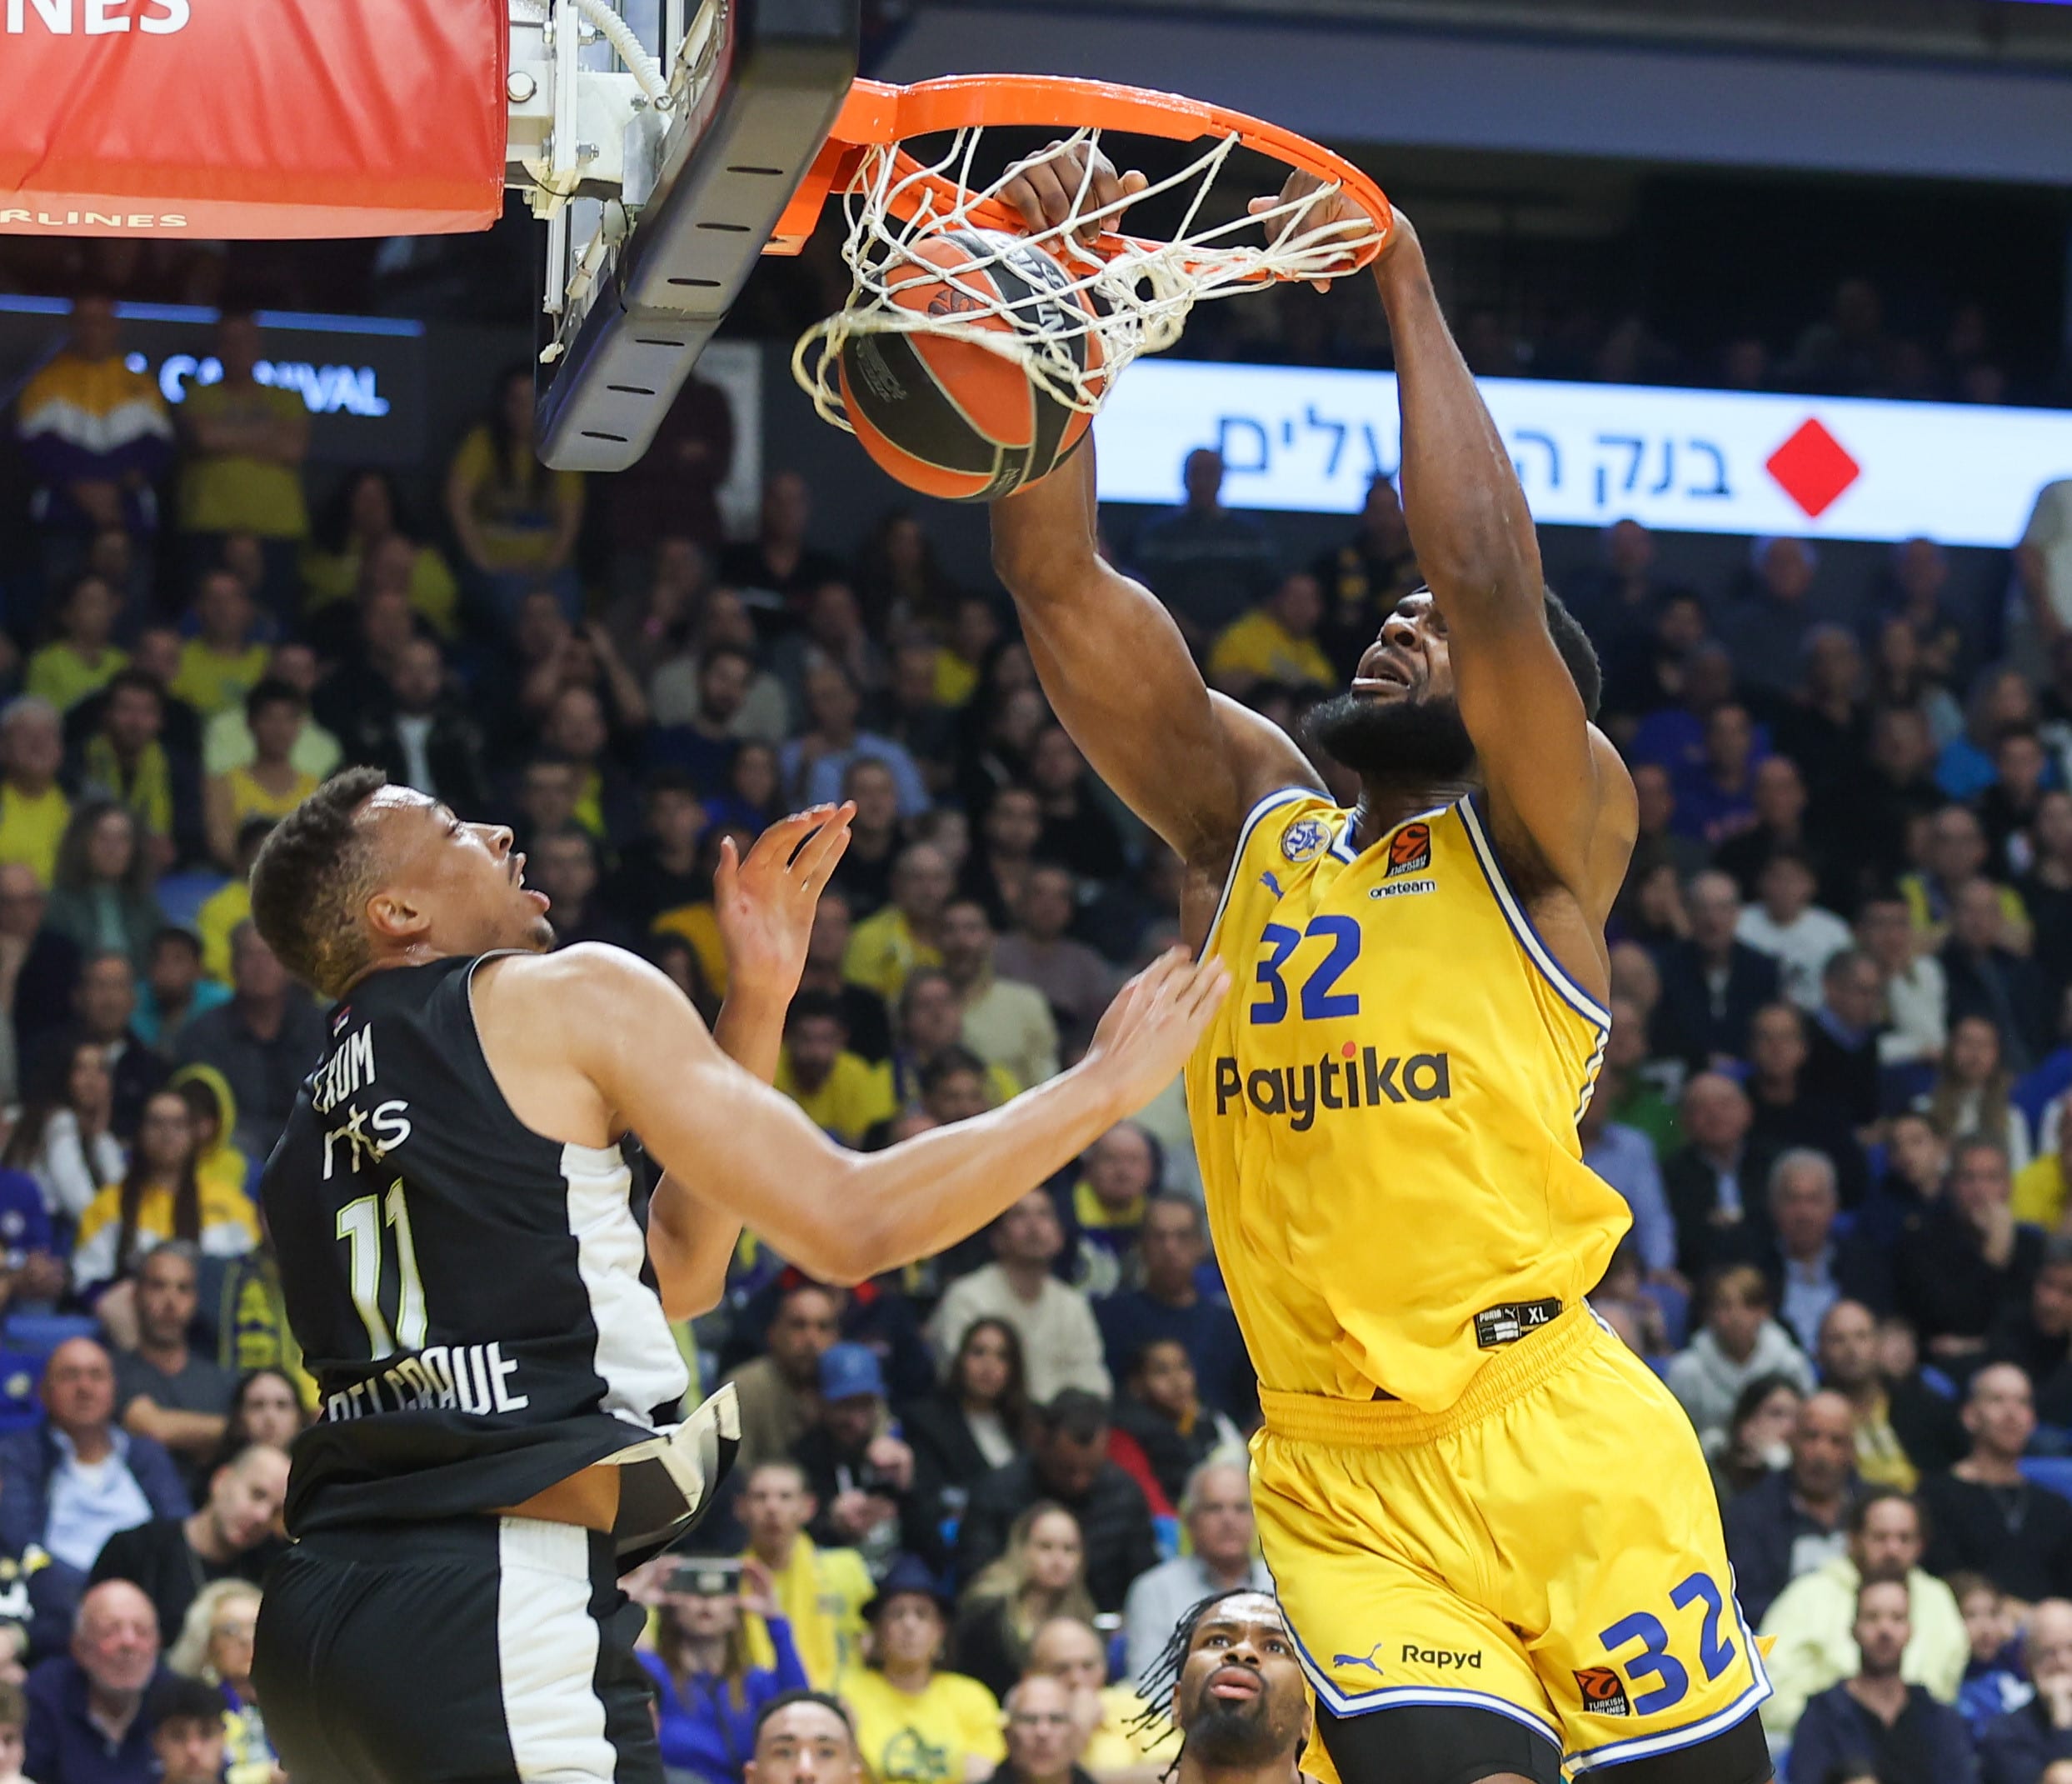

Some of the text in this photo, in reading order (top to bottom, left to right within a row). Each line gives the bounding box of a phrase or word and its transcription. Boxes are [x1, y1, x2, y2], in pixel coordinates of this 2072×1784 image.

[1593, 433, 1732, 505] בנק
[1369, 881, 1435, 898] oneteam
[1251, 914, 1361, 1025] 32
[1216, 1041, 1451, 1132] Paytika
[336, 1175, 429, 1362] 11
[1527, 1306, 1550, 1325] XL
[1401, 1644, 1481, 1670] Rapyd
[1598, 1572, 1736, 1717] 32
[1588, 1695, 1625, 1710] TURKISH
